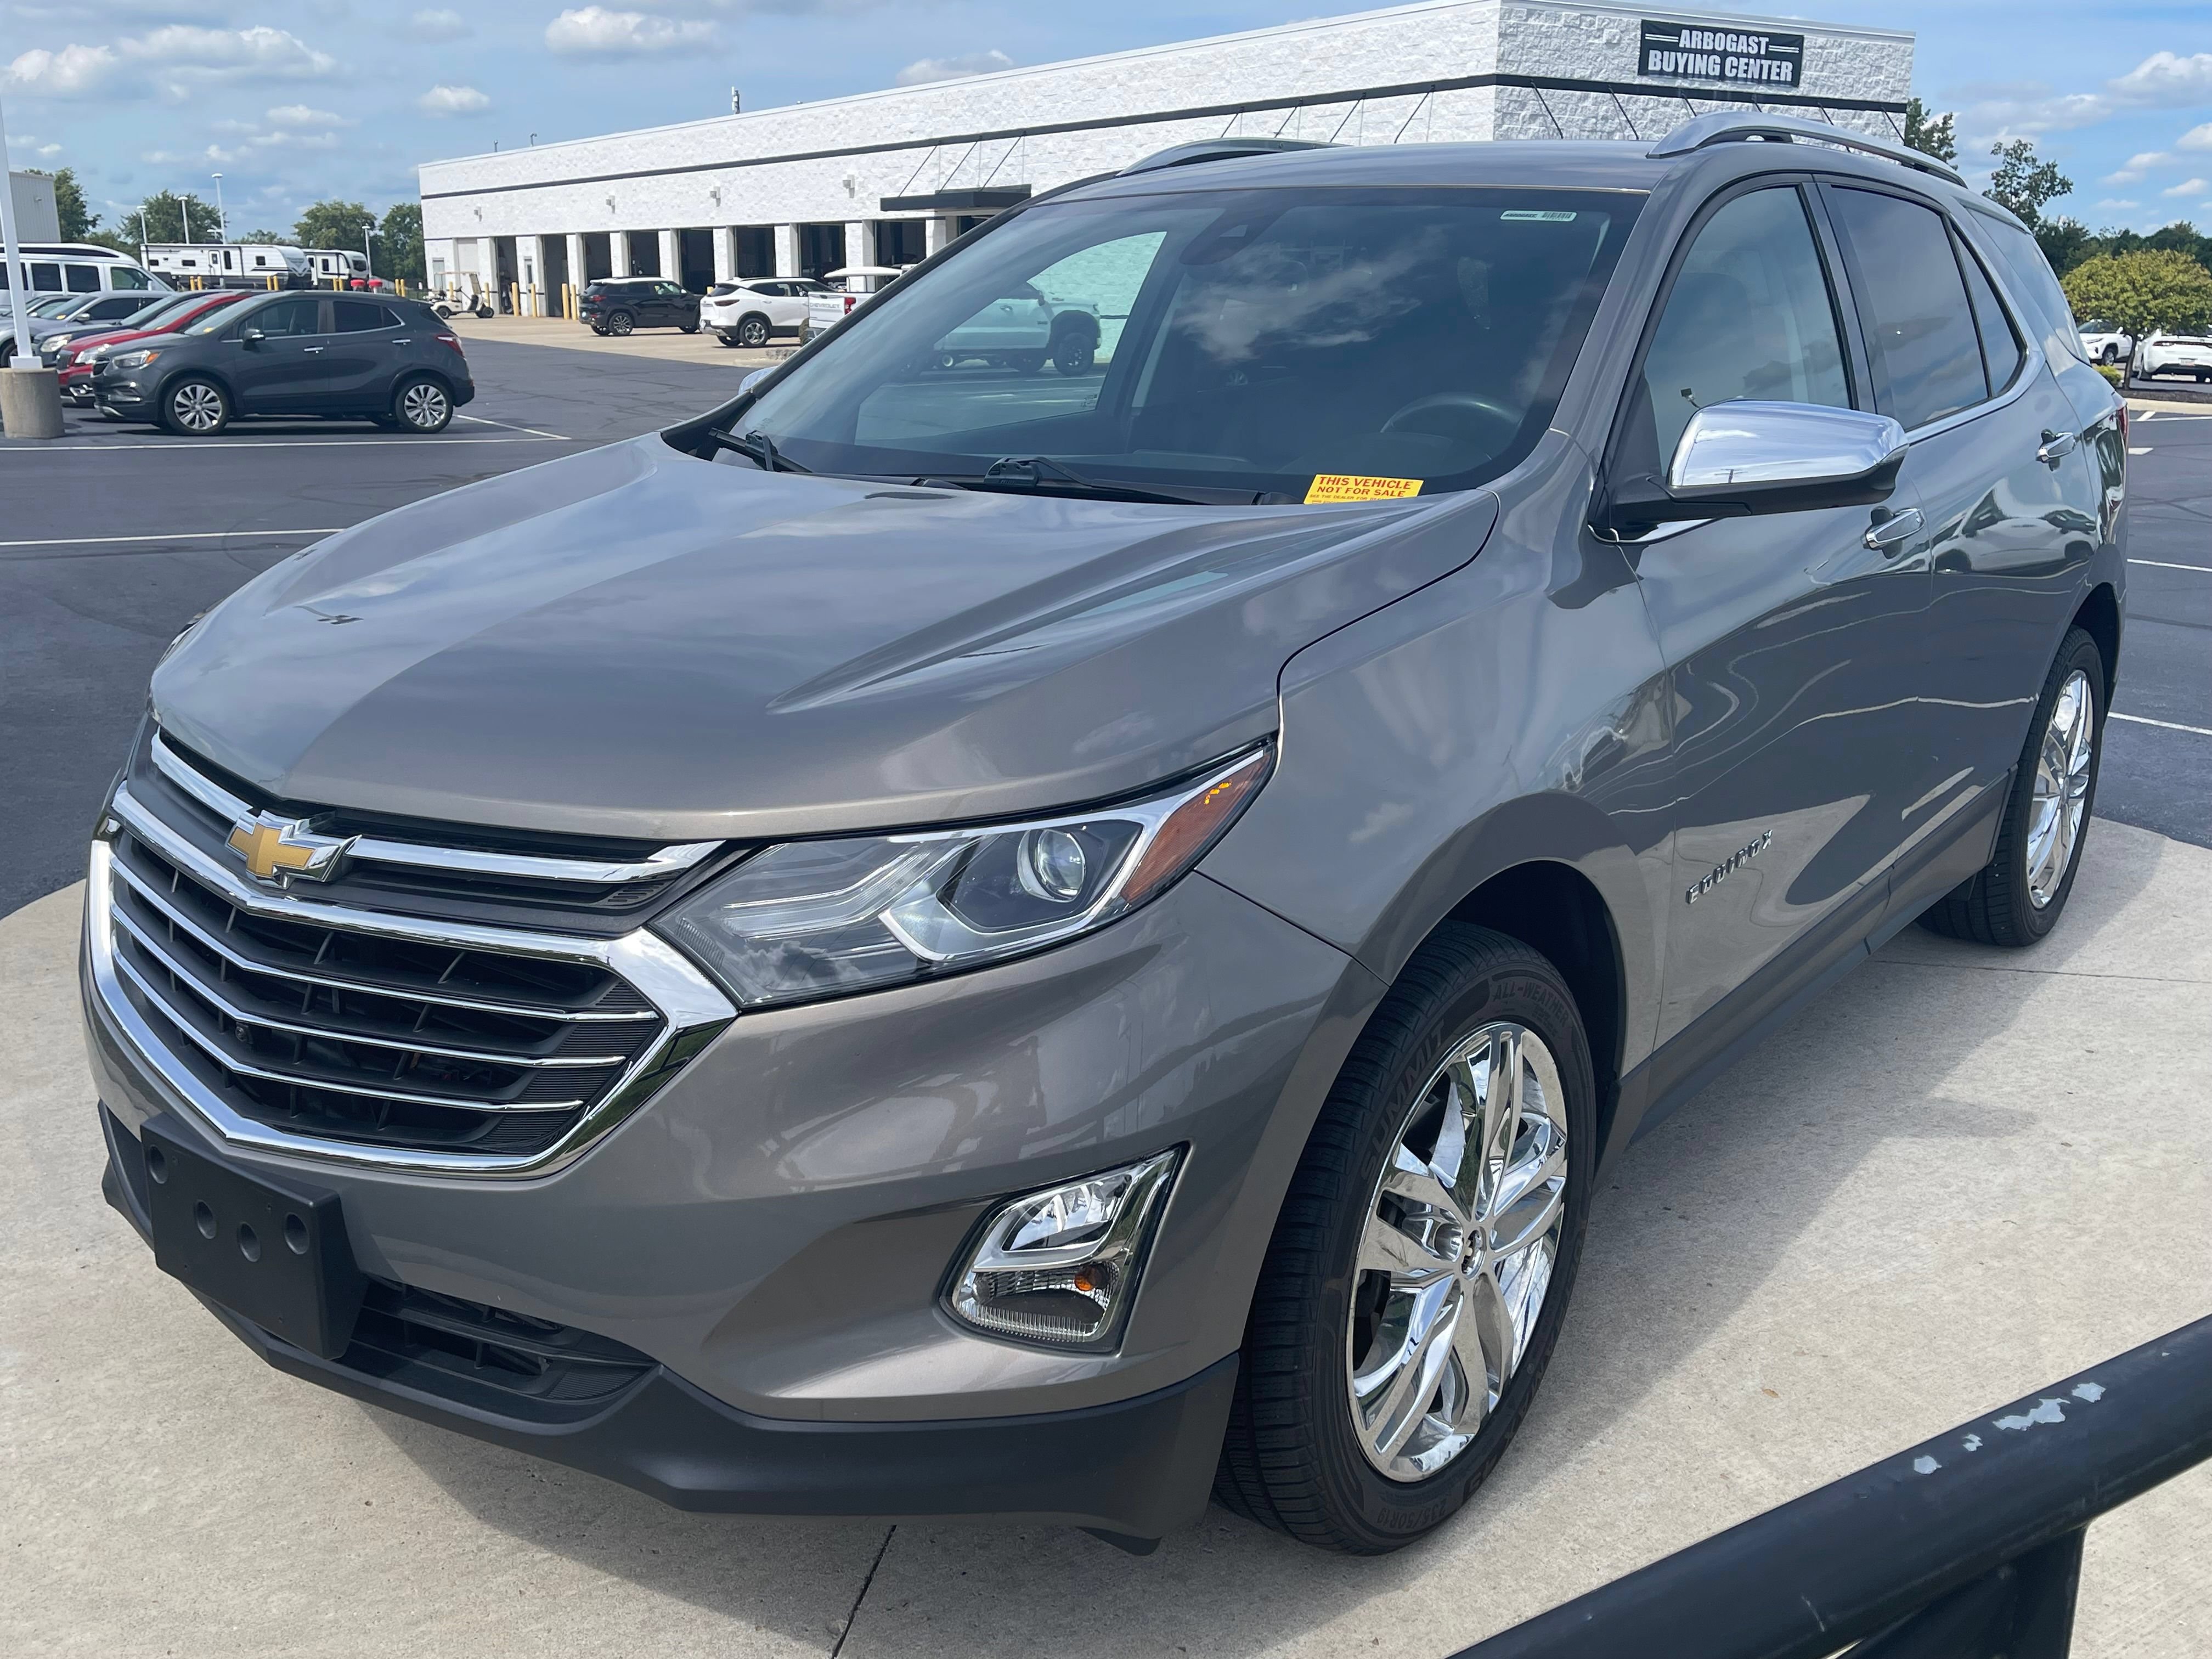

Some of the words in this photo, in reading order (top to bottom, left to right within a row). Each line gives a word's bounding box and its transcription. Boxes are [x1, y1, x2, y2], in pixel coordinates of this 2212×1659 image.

[1679, 29, 1769, 55] ARBOGAST
[1648, 49, 1721, 76] BUYING
[1725, 56, 1794, 82] CENTER
[1319, 476, 1349, 486] THIS
[1355, 478, 1413, 489] VEHICLE
[1345, 487, 1370, 495] FOR
[1374, 489, 1406, 497] SALE
[1492, 979, 1570, 1029] ALL-WEATHER
[1359, 1018, 1447, 1183] SUMMIT
[1376, 1498, 1447, 1530] 235/50R19
